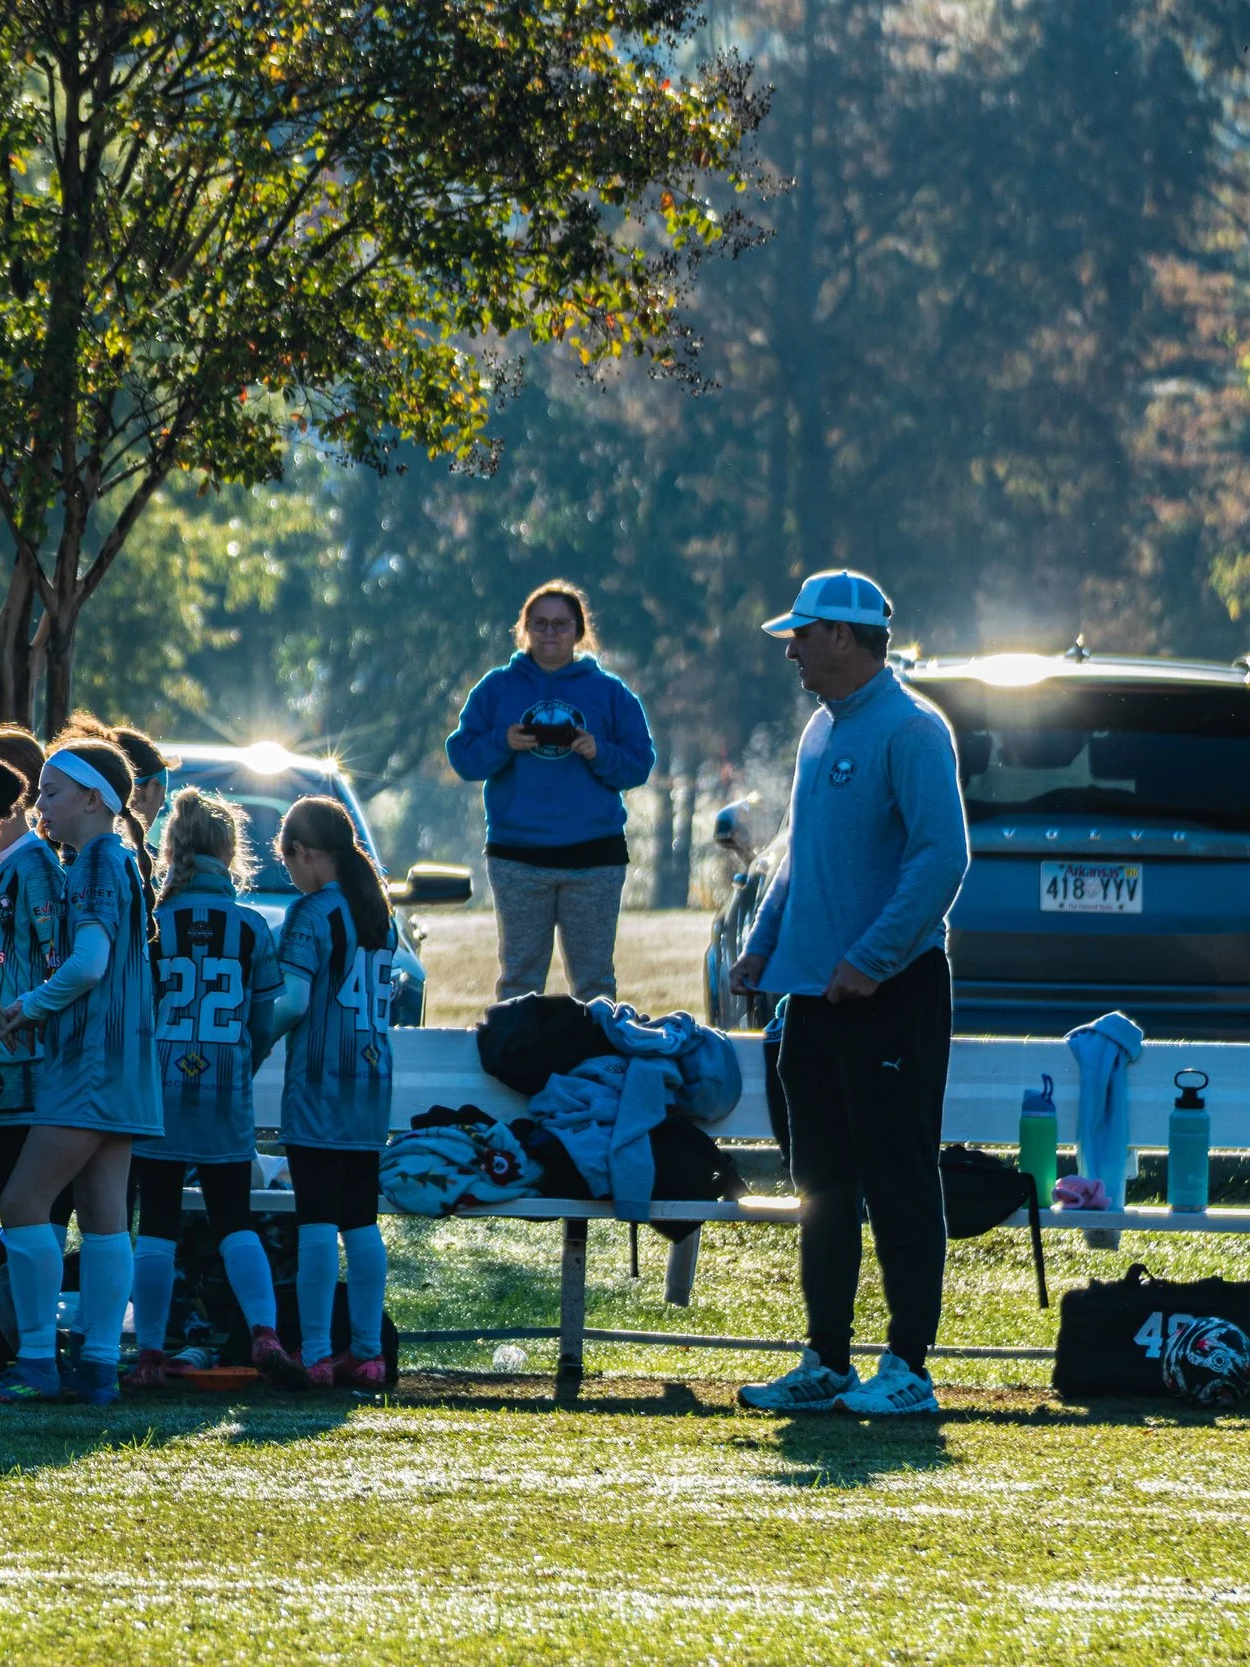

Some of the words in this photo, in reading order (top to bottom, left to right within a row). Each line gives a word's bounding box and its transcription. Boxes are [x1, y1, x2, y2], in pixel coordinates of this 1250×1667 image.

[1003, 827, 1186, 841] VOLVO
[1046, 876, 1085, 901] 418
[1100, 877, 1138, 902] YYV
[156, 956, 244, 1043] 22
